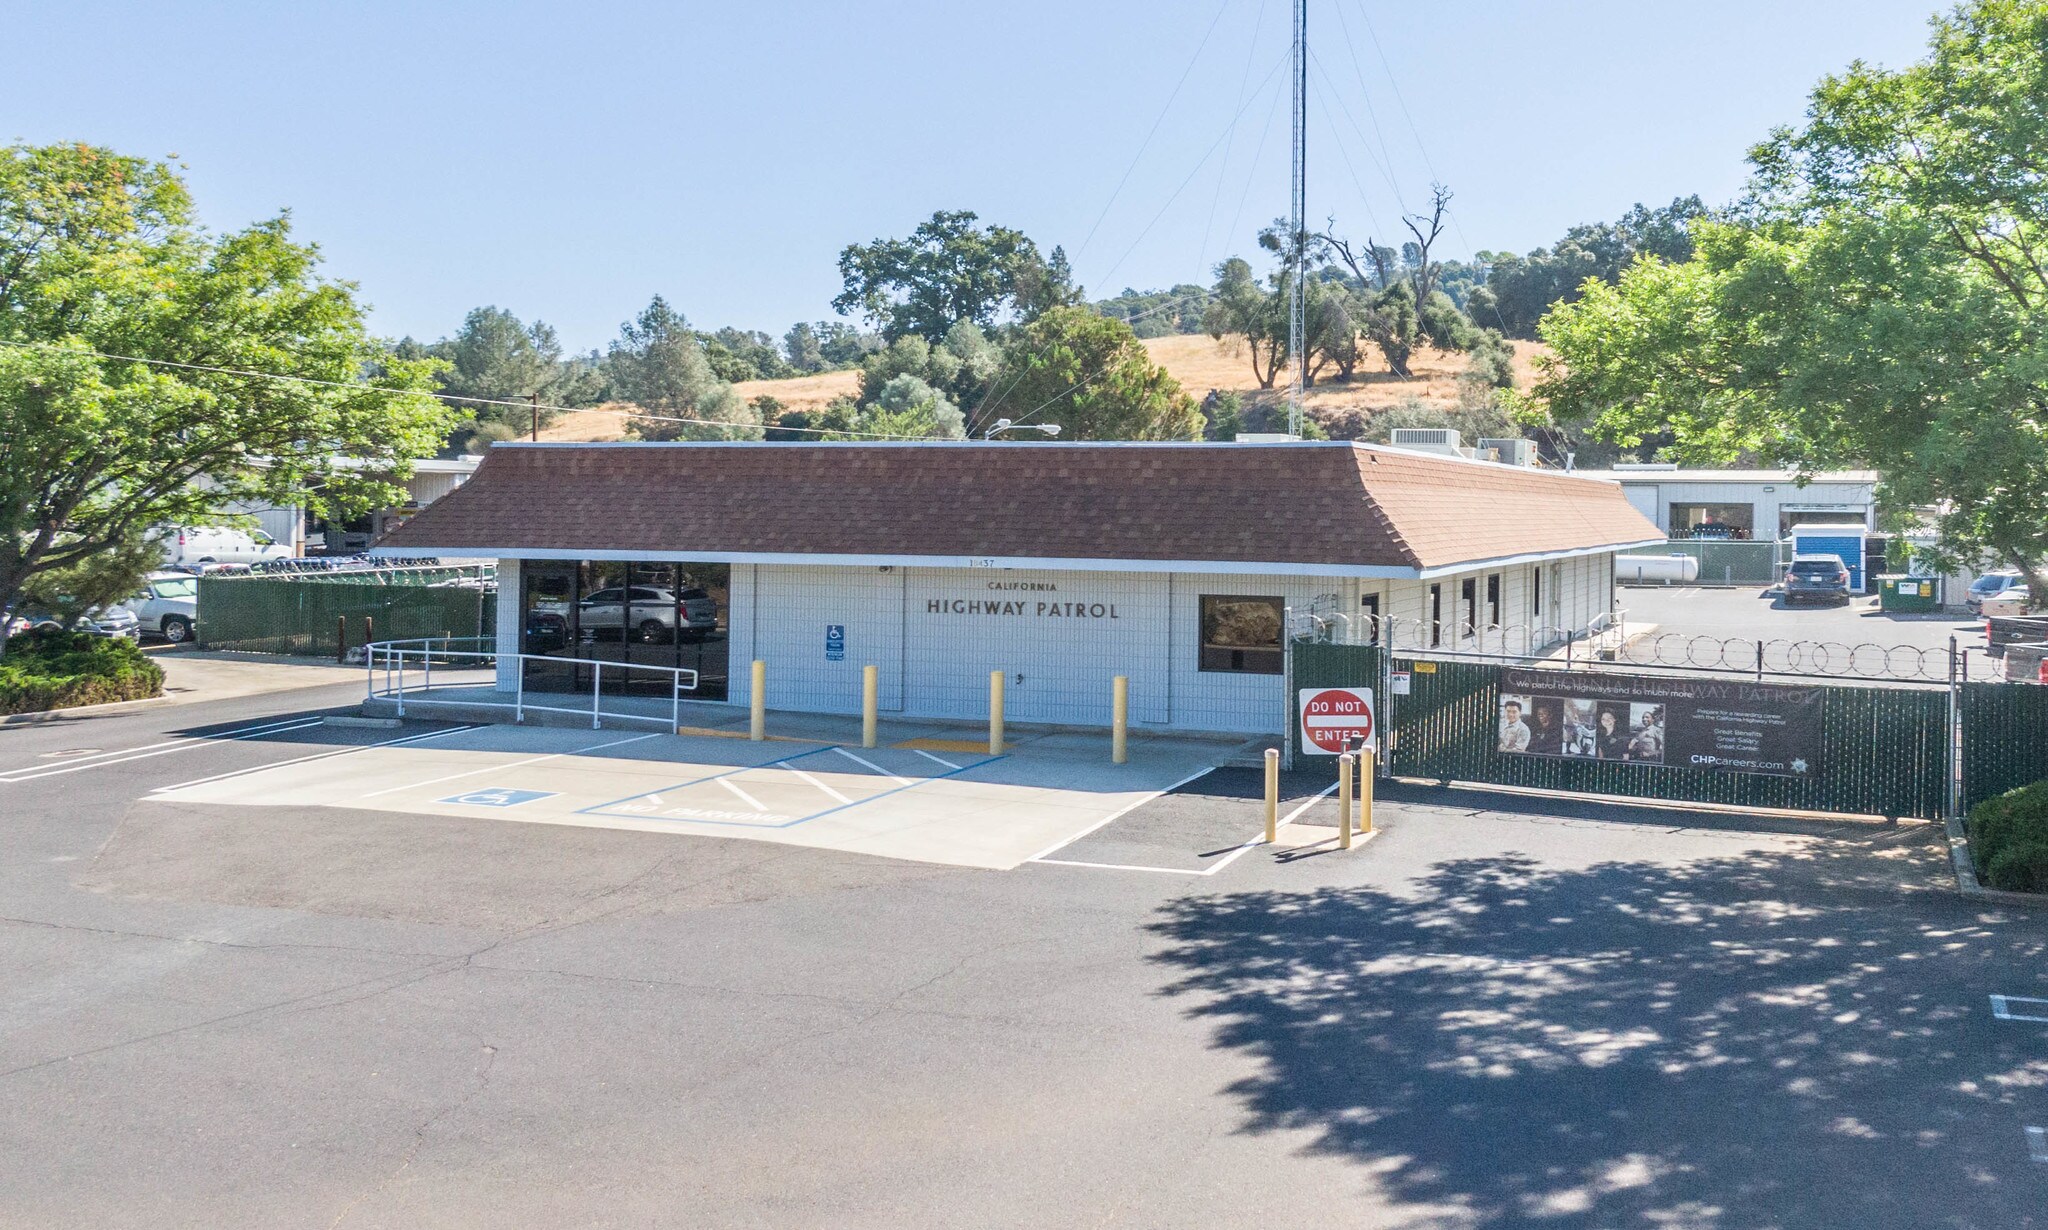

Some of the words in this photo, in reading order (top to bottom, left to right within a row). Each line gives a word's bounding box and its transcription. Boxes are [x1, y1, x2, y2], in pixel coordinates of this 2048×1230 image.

[988, 581, 1057, 592] CALIFORNIA
[927, 599, 1025, 616] HIGHWAY
[1036, 602, 1119, 619] PATROL
[1516, 680, 1529, 688] We
[1531, 681, 1555, 690] patrol
[1557, 683, 1571, 691] the
[1573, 684, 1612, 694] highways
[1613, 686, 1629, 694] and
[1644, 688, 1668, 697] much
[1311, 702, 1329, 713] DO
[1335, 701, 1361, 713] NOT
[1690, 754, 1784, 770] CHPcareers.com
